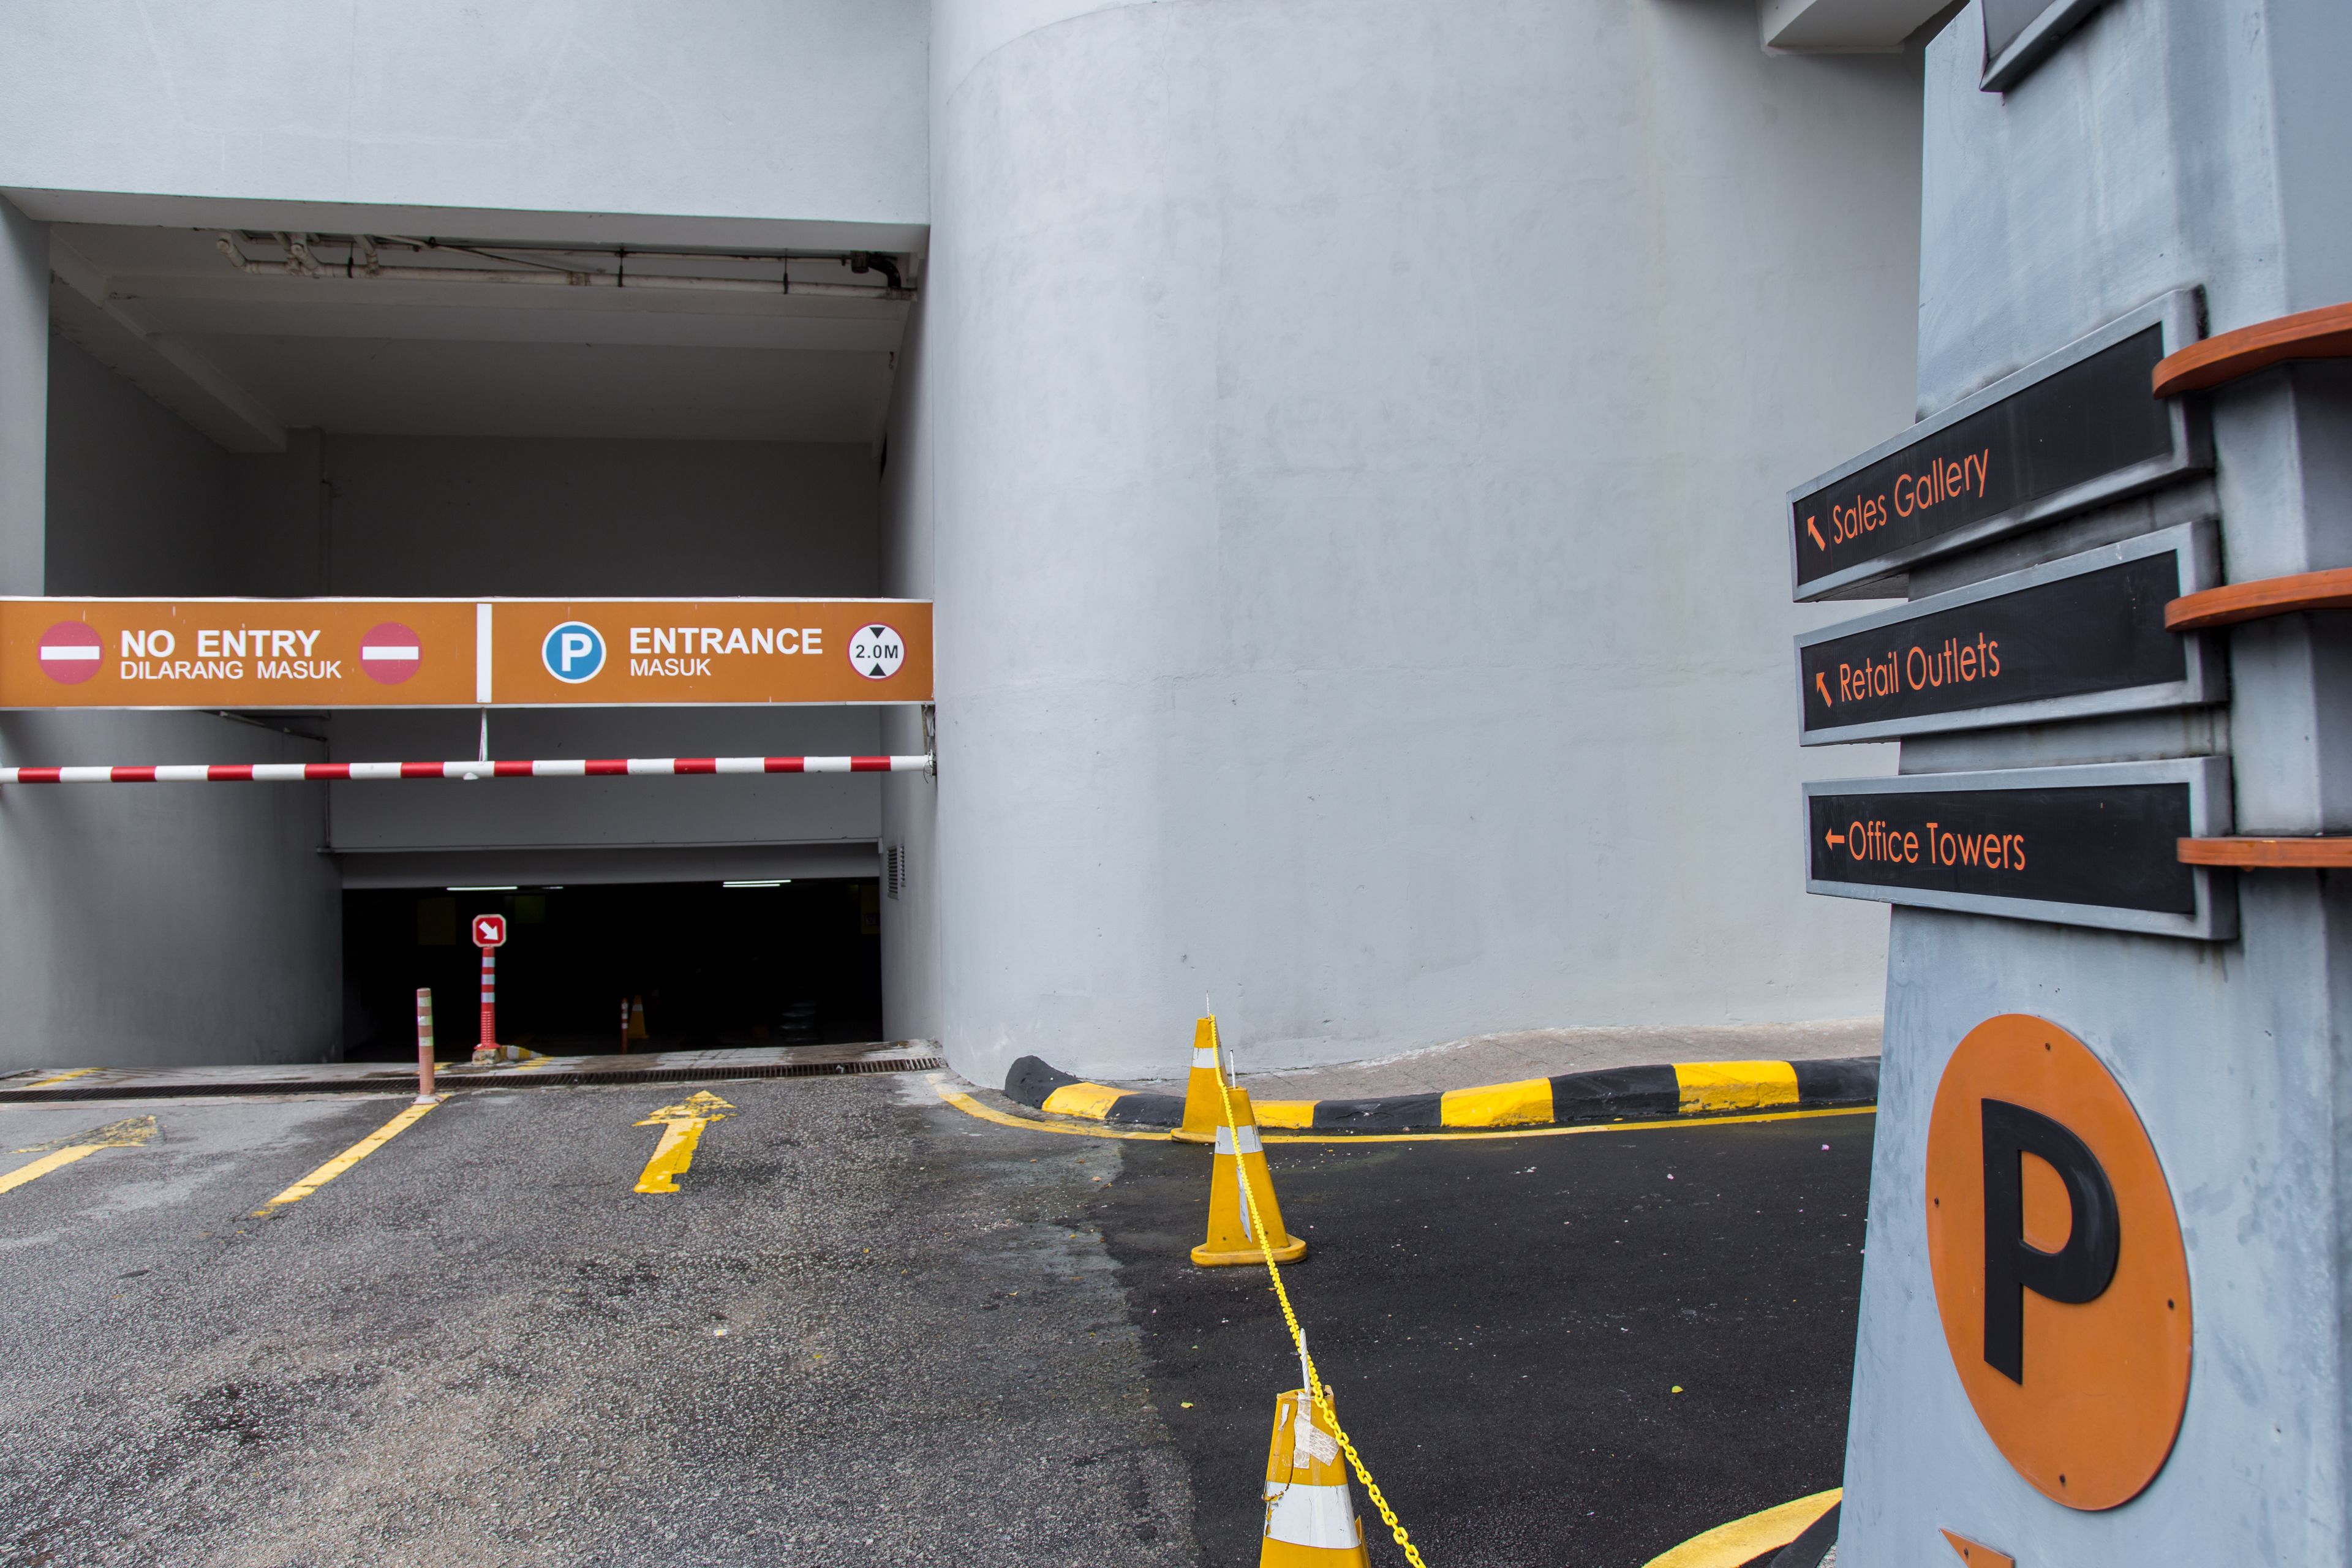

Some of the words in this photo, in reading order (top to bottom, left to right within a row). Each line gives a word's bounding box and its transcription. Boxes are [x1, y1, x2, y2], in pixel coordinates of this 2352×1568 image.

[1834, 495, 1887, 544] Sales
[1895, 450, 1988, 517] Gallery
[122, 630, 175, 657] NO
[198, 630, 320, 657] ENTRY
[562, 633, 592, 671] P
[630, 628, 822, 654] ENTRANCE
[856, 646, 897, 658] 2.0M
[121, 661, 243, 679] DILARANG
[258, 661, 341, 679] MASUK
[631, 658, 710, 676] MASUK
[1840, 652, 1899, 701] Retail
[1907, 633, 1999, 690] Outlets
[1849, 821, 1918, 863] Office
[1927, 823, 2025, 870] Towers
[1982, 1098, 2120, 1385] P
